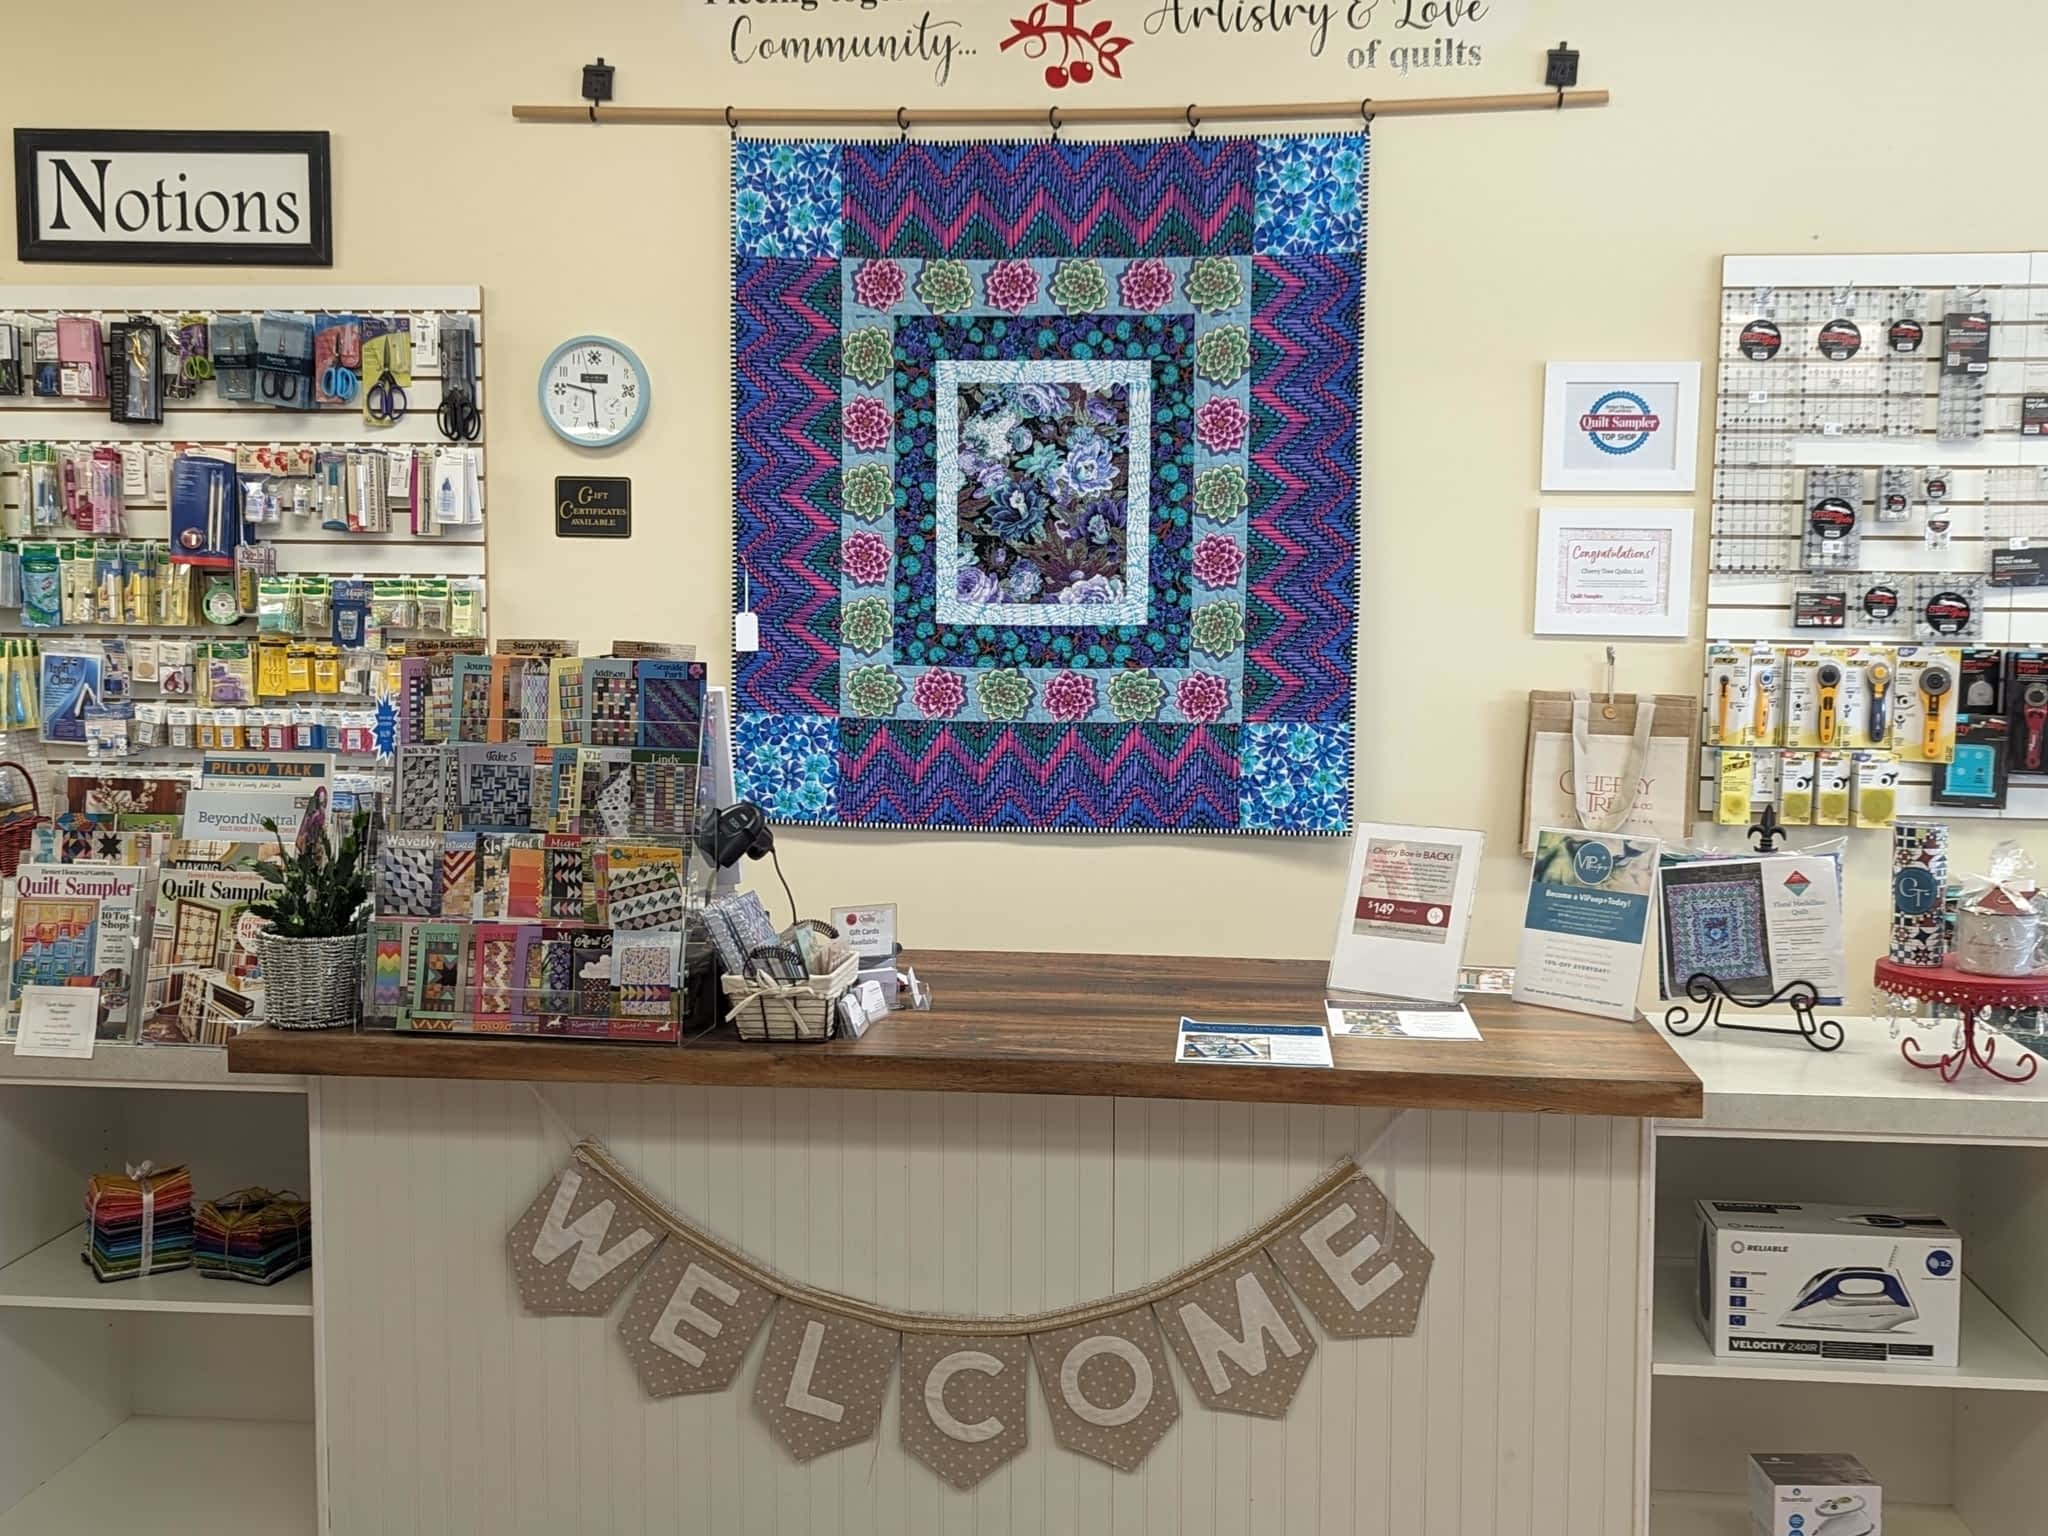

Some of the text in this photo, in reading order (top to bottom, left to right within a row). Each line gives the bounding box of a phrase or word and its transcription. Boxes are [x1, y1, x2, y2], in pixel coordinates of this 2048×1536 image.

[1347, 38, 1482, 77] of quilts
[49, 158, 300, 234] Notions
[1582, 415, 1657, 431] Quilt Sampler
[1601, 433, 1637, 441] TOP SHOP
[1572, 545, 1656, 564] Congratulations!
[416, 641, 475, 650] Chain Reaction
[513, 641, 561, 652] Starry Night
[593, 669, 627, 678] Addison
[486, 751, 509, 762] Take
[651, 753, 680, 765] Lindy
[212, 762, 313, 776] PILLOW TALK
[198, 811, 248, 826] Beyond
[386, 834, 437, 849] Waverly
[1373, 847, 1398, 857] Cherry
[1423, 851, 1454, 861] BACK!
[17, 875, 135, 900] Quilt Sampler
[162, 878, 207, 901] Quilt
[102, 911, 113, 920] 10
[101, 921, 130, 932] Shops
[862, 928, 880, 936] Cards
[850, 938, 878, 946] Available
[1747, 1245, 1789, 1253] RELIABLE
[531, 1168, 1404, 1443] WELCOME
[1731, 1340, 1786, 1351] VELOCITY
